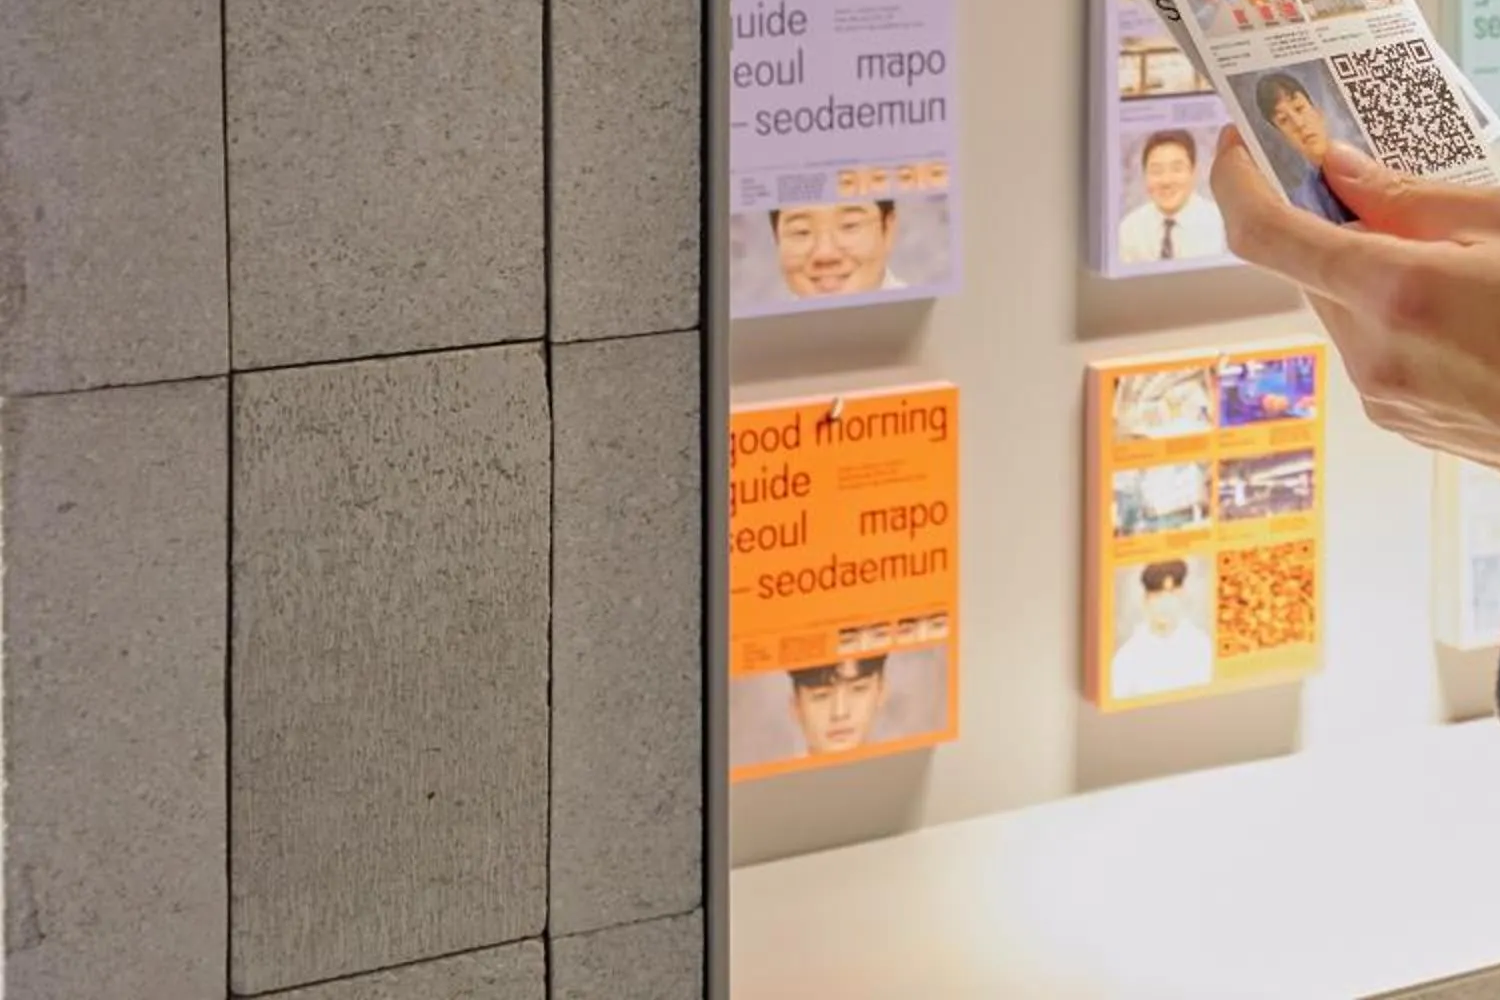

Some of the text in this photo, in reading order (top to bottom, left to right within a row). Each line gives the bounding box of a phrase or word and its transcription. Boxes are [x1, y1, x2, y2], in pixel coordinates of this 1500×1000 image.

[736, 1, 808, 39] uide
[733, 47, 946, 88] eoul mapo
[754, 94, 946, 136] seodaemun
[815, 399, 947, 447] morning
[730, 500, 948, 554] eoul mapo
[757, 548, 948, 600] seodaemun
